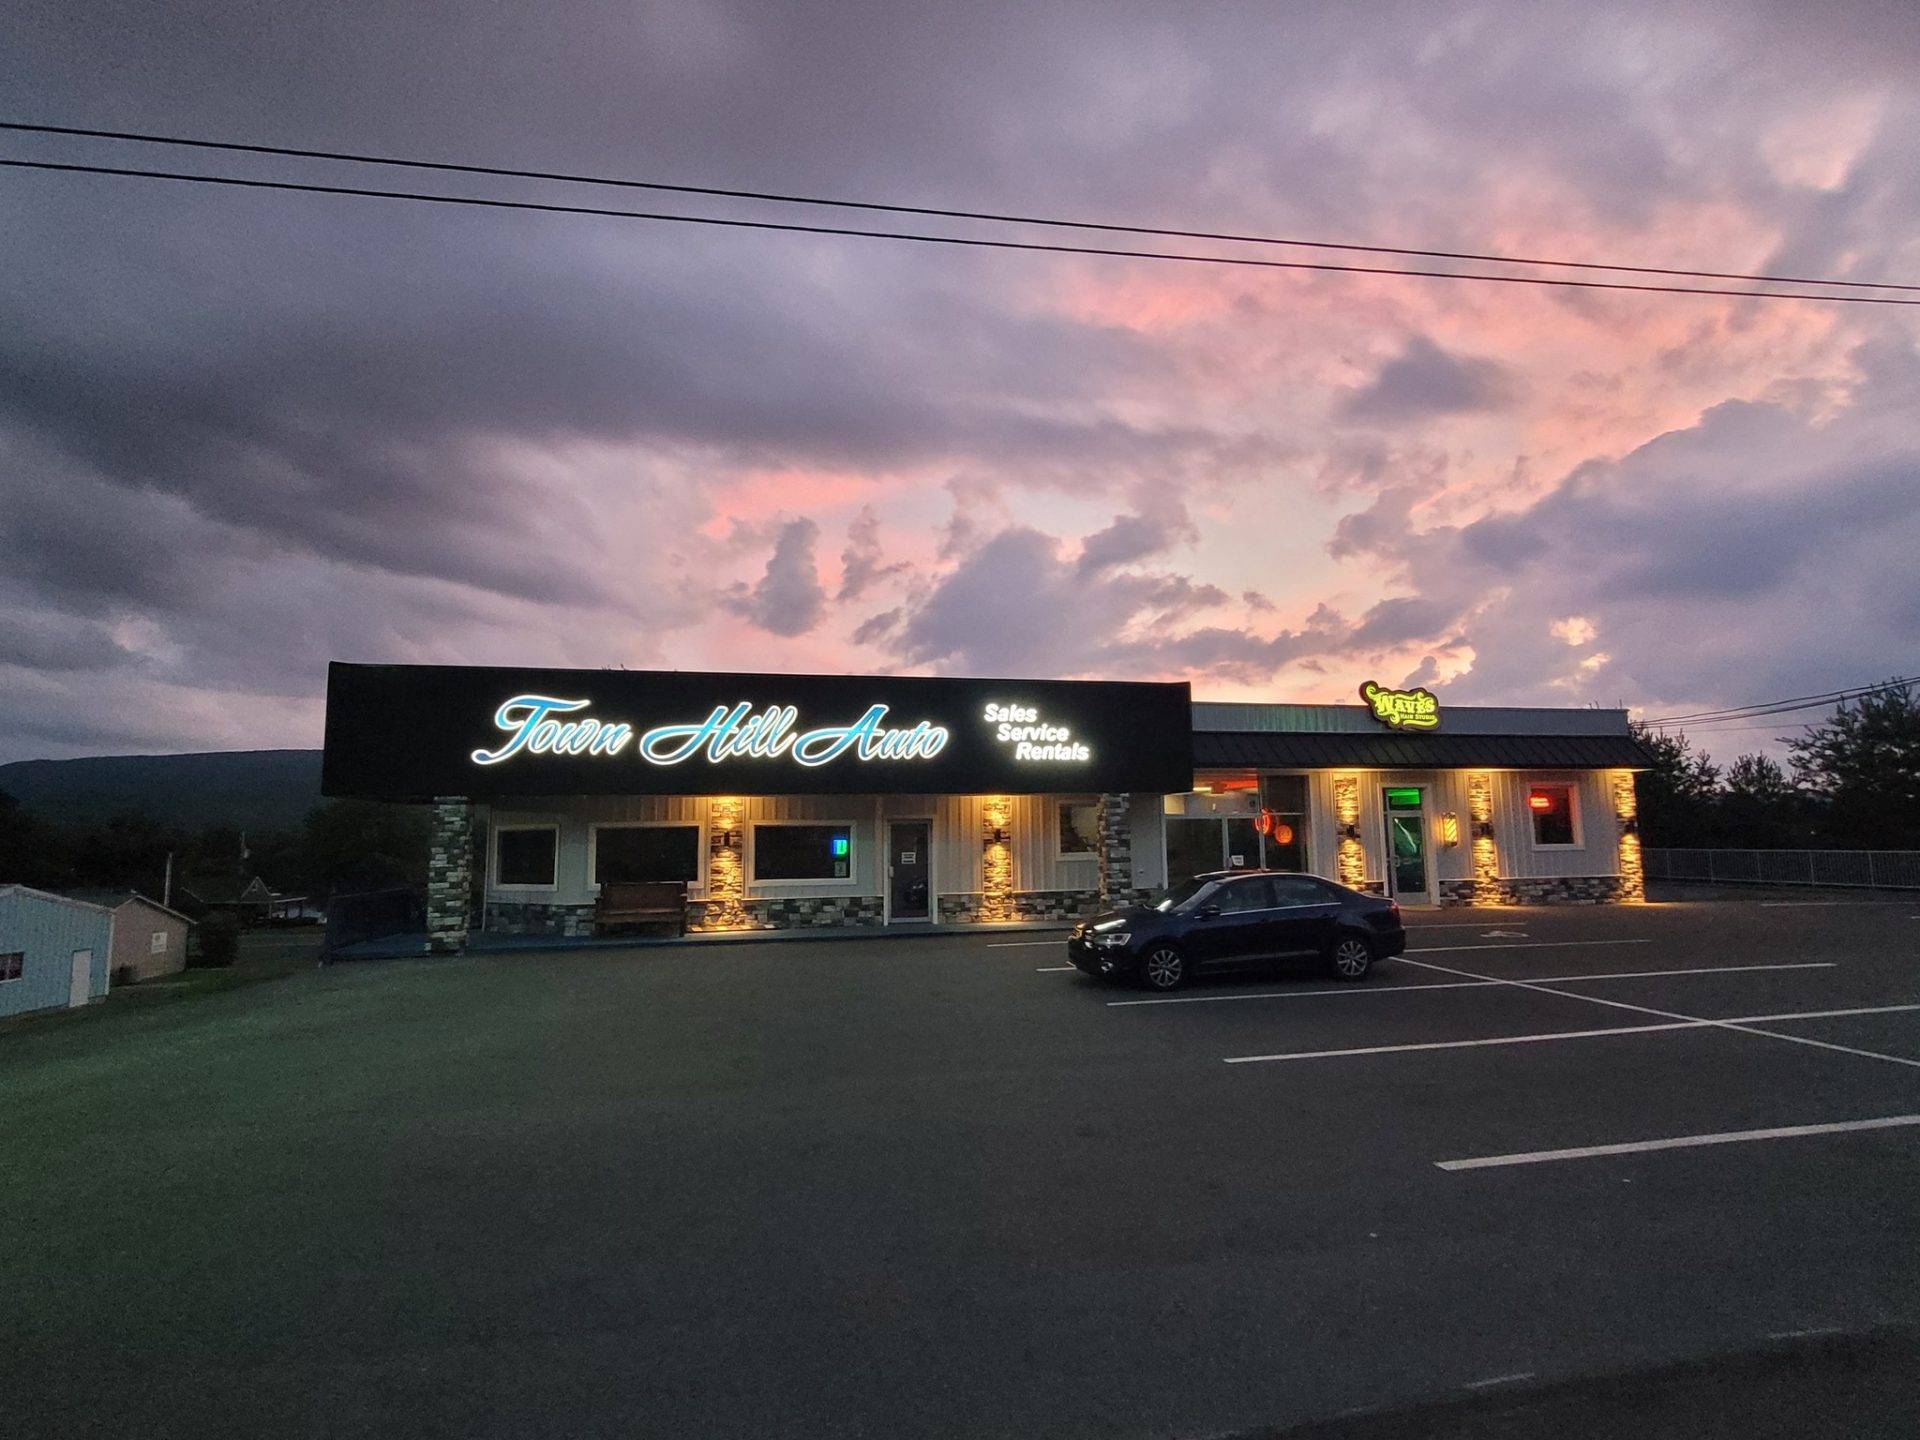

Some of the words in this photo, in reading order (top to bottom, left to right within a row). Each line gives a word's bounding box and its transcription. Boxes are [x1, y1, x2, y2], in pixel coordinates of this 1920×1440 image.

[984, 703, 1038, 722] Sales
[471, 694, 633, 765] Town
[639, 701, 798, 765] Hill
[792, 704, 948, 767] Auto
[996, 723, 1069, 742] Service
[1015, 742, 1090, 761] Rentals
